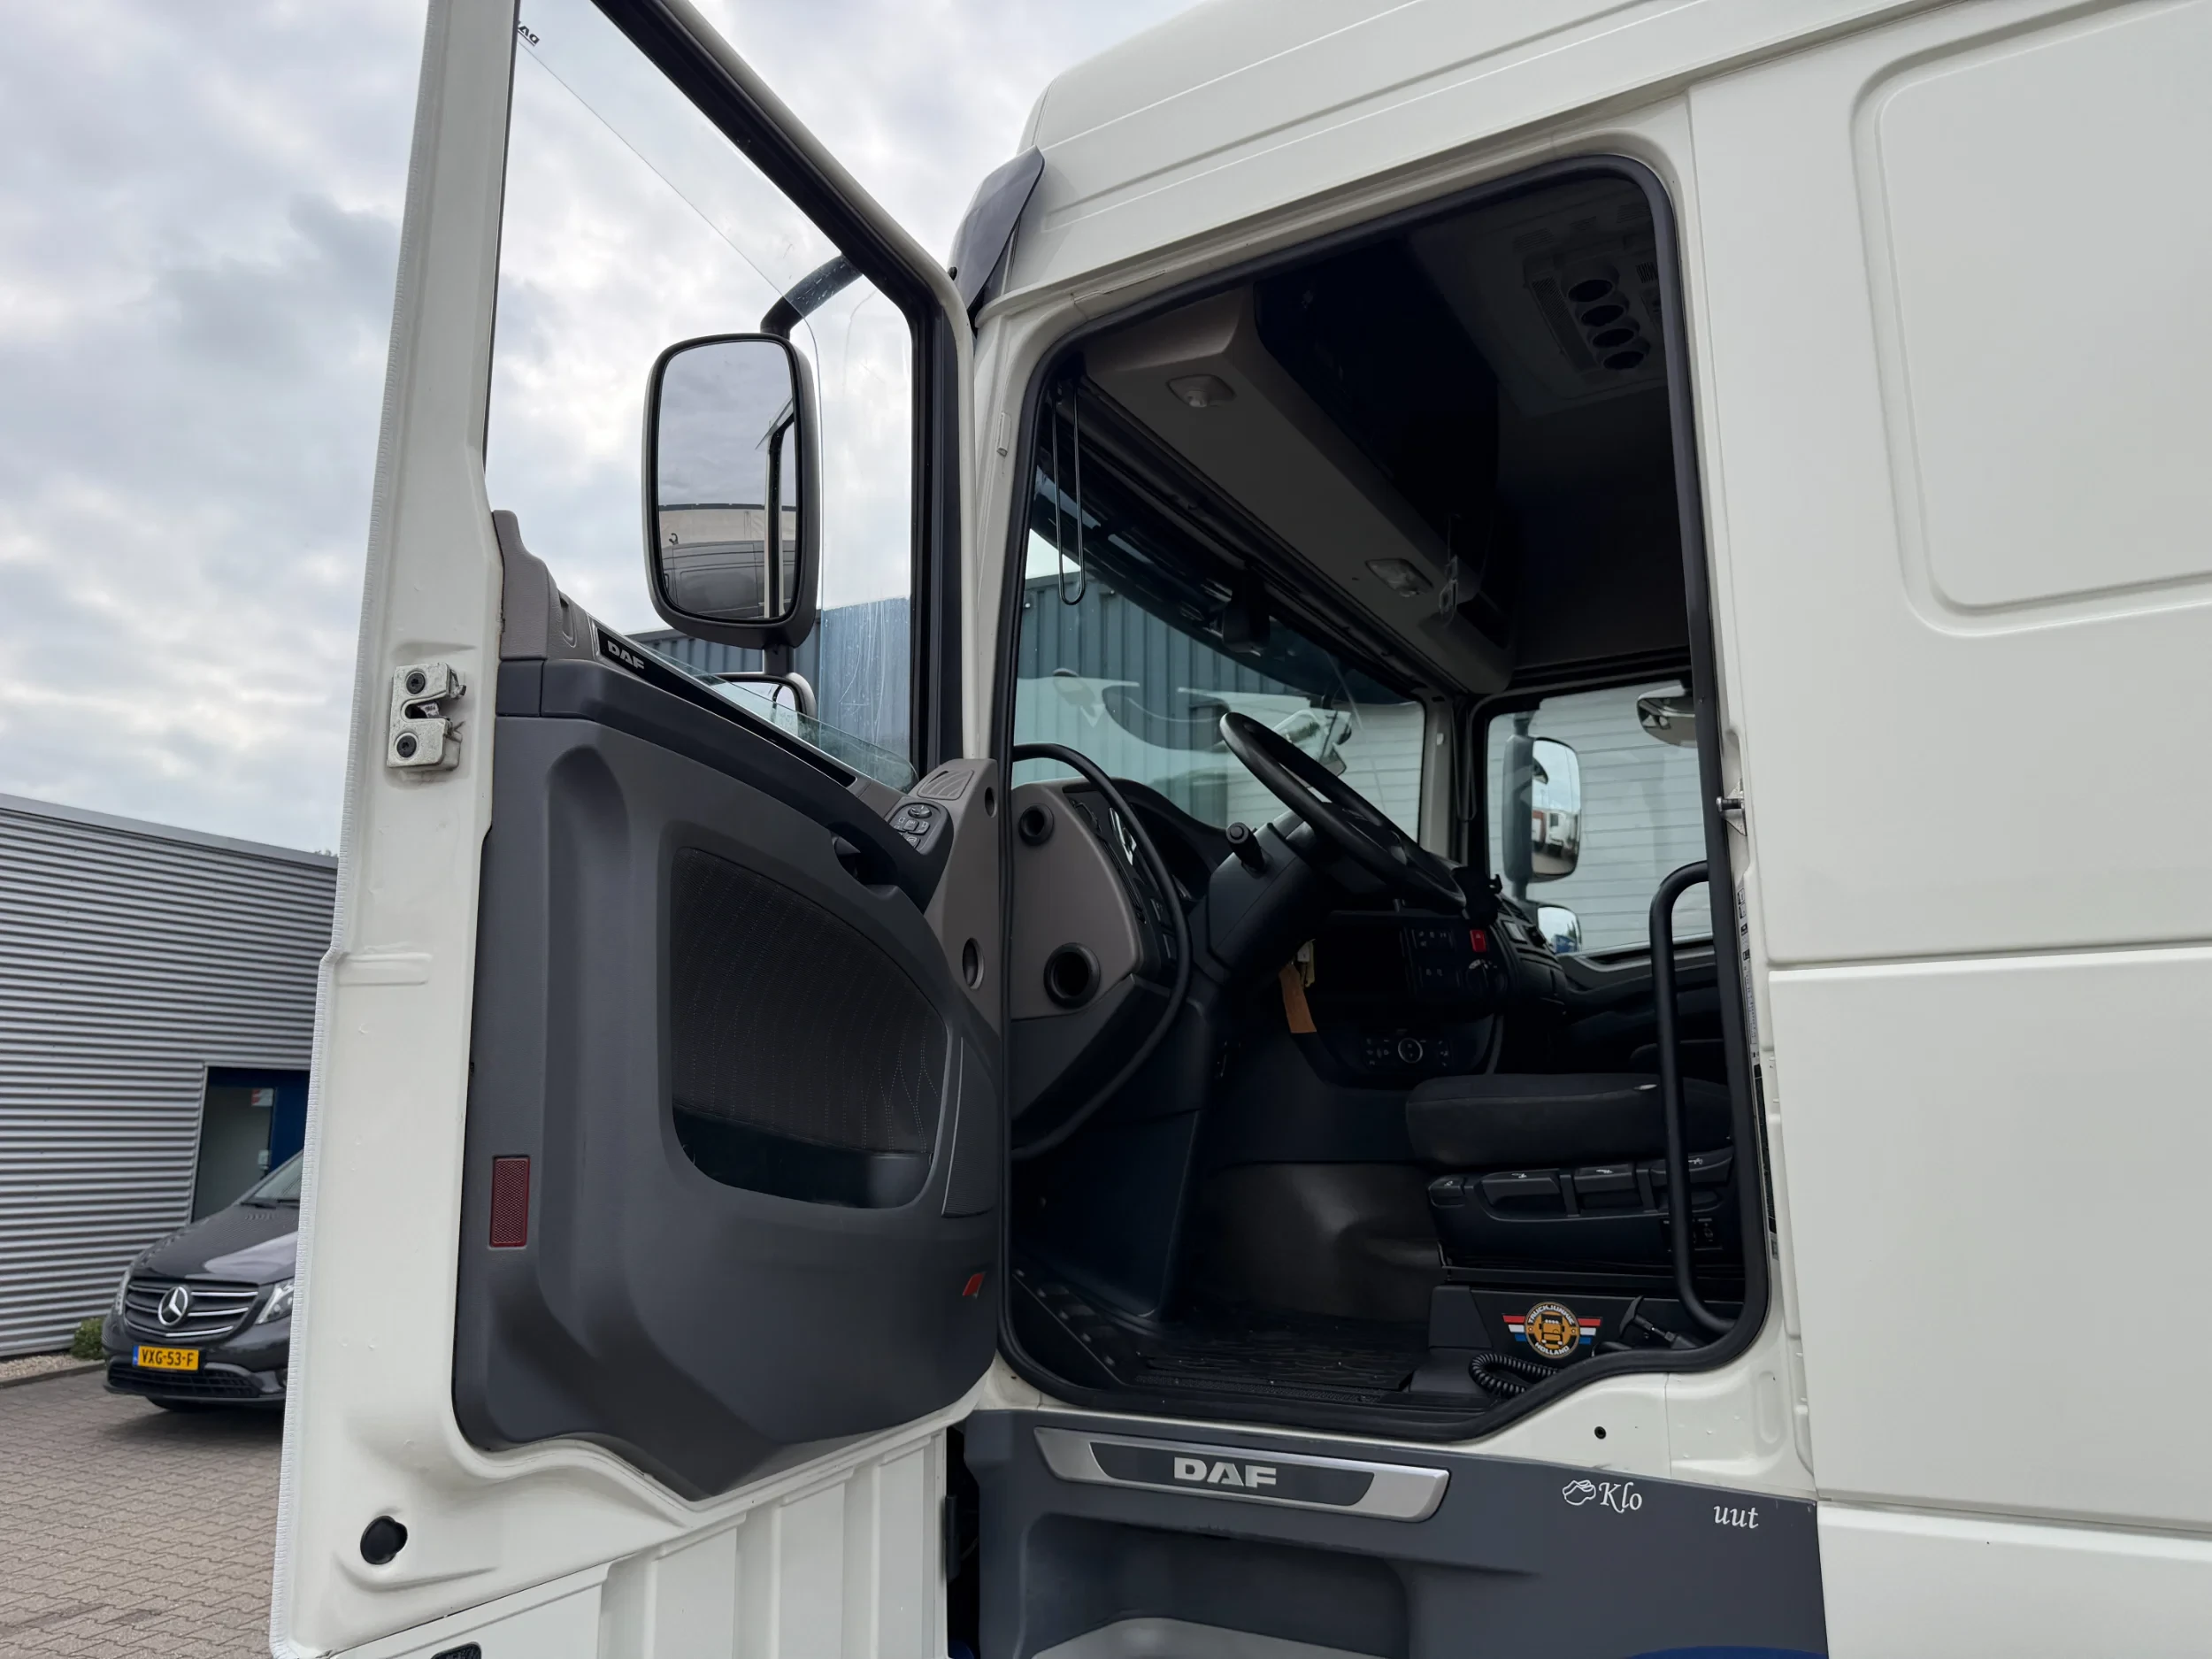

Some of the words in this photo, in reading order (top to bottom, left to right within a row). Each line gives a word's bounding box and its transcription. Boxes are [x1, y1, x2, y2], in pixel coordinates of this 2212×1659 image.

[607, 640, 645, 670] DAF
[1528, 1304, 1575, 1325] TRUCKJUNKIE
[142, 1348, 194, 1366] VXG-53-F
[1534, 1341, 1570, 1356] HOLLAND
[1174, 1456, 1277, 1488] DAF
[1599, 1481, 1643, 1514] Klo
[1713, 1504, 1759, 1529] uut
